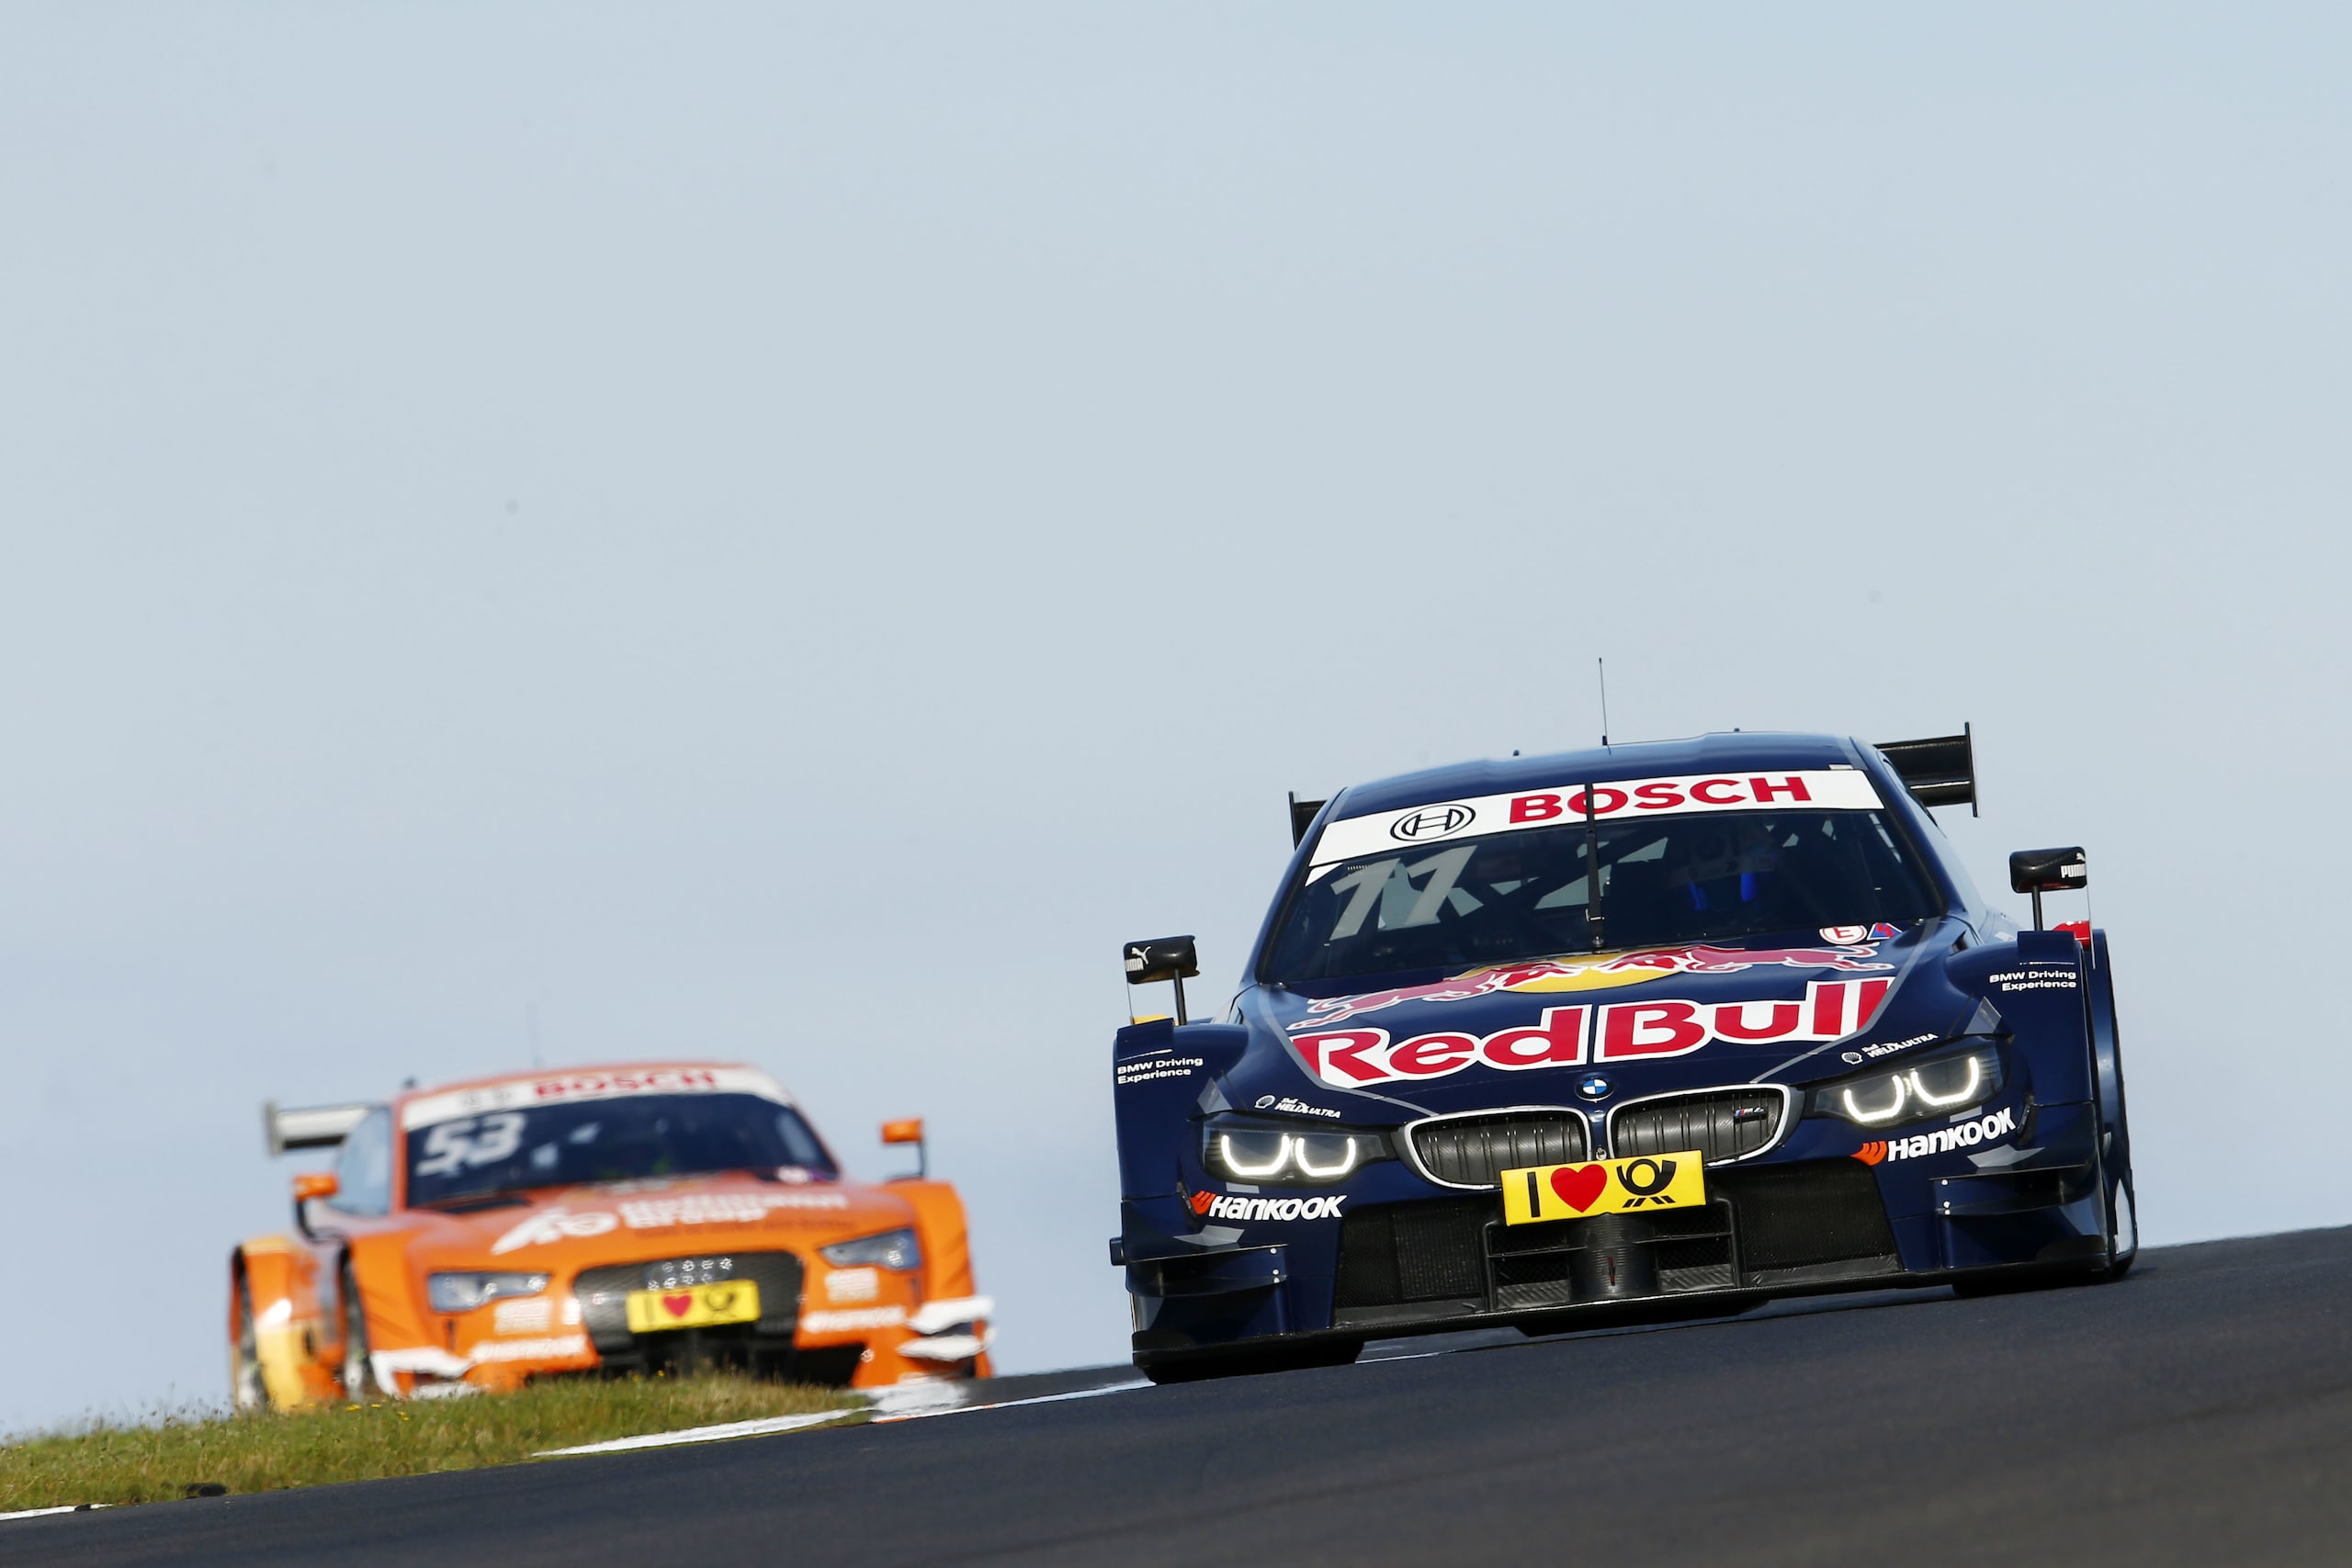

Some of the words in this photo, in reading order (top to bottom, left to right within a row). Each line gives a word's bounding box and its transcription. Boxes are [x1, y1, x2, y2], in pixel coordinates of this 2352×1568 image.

[1510, 777, 1811, 824] BOSCH
[1989, 972, 2025, 983] BMW
[2029, 970, 2076, 980] Driving
[2002, 979, 2076, 991] Experience
[1290, 1005, 1592, 1089] Red
[1595, 976, 1894, 1063] Bull
[1117, 1062, 1153, 1075] BMW
[1156, 1057, 1204, 1069] Driving
[1117, 1067, 1192, 1085] Experience
[535, 1070, 718, 1099] BOSCH
[416, 1112, 526, 1177] 53
[1527, 1171, 1541, 1218] I
